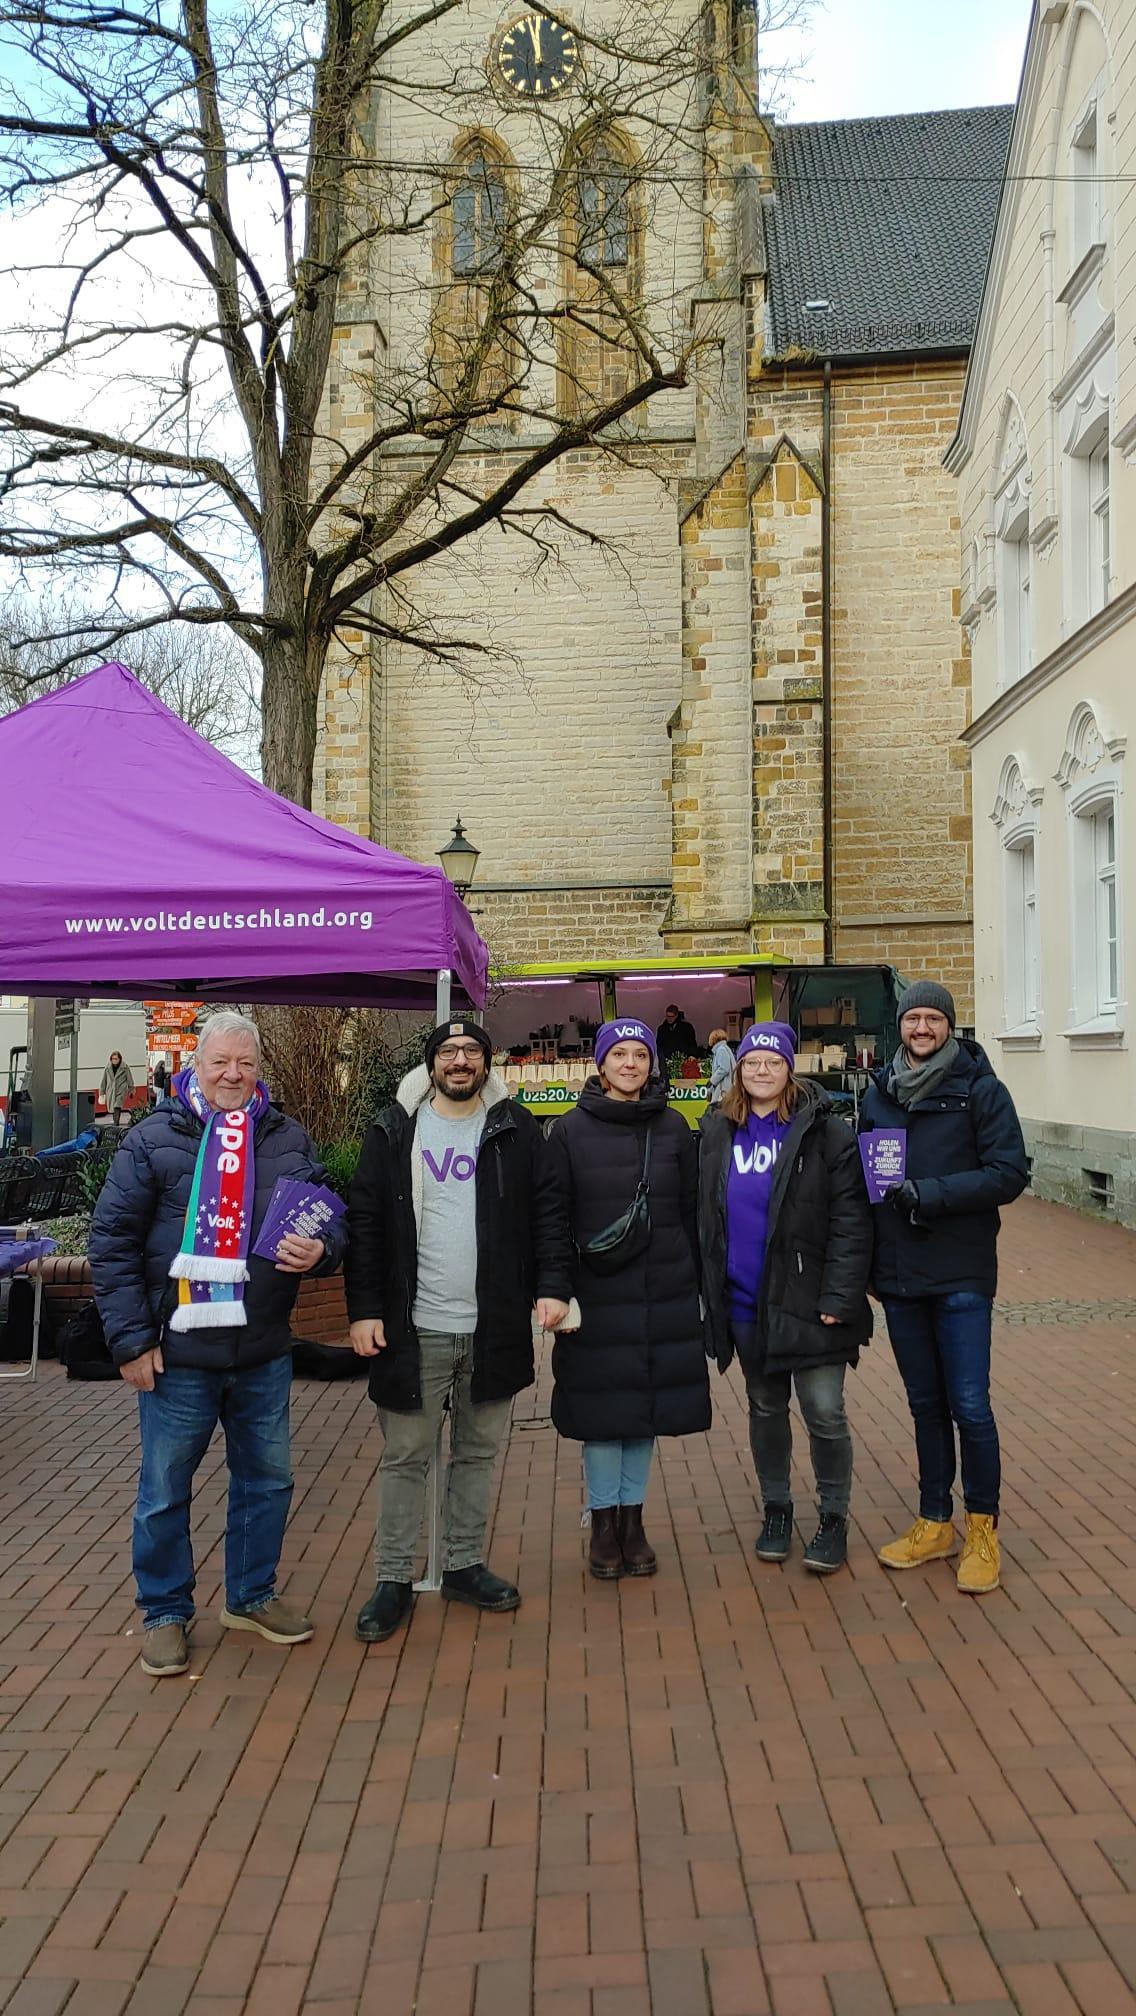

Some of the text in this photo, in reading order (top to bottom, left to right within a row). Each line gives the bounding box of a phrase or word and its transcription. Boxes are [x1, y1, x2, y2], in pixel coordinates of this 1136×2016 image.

[65, 908, 373, 933] www.voltdeutschland.org
[614, 1025, 645, 1039] Volt
[751, 1033, 781, 1050] Volt
[523, 1088, 581, 1101] 02520/3
[422, 1146, 480, 1182] Vo
[207, 1213, 235, 1230] Volt
